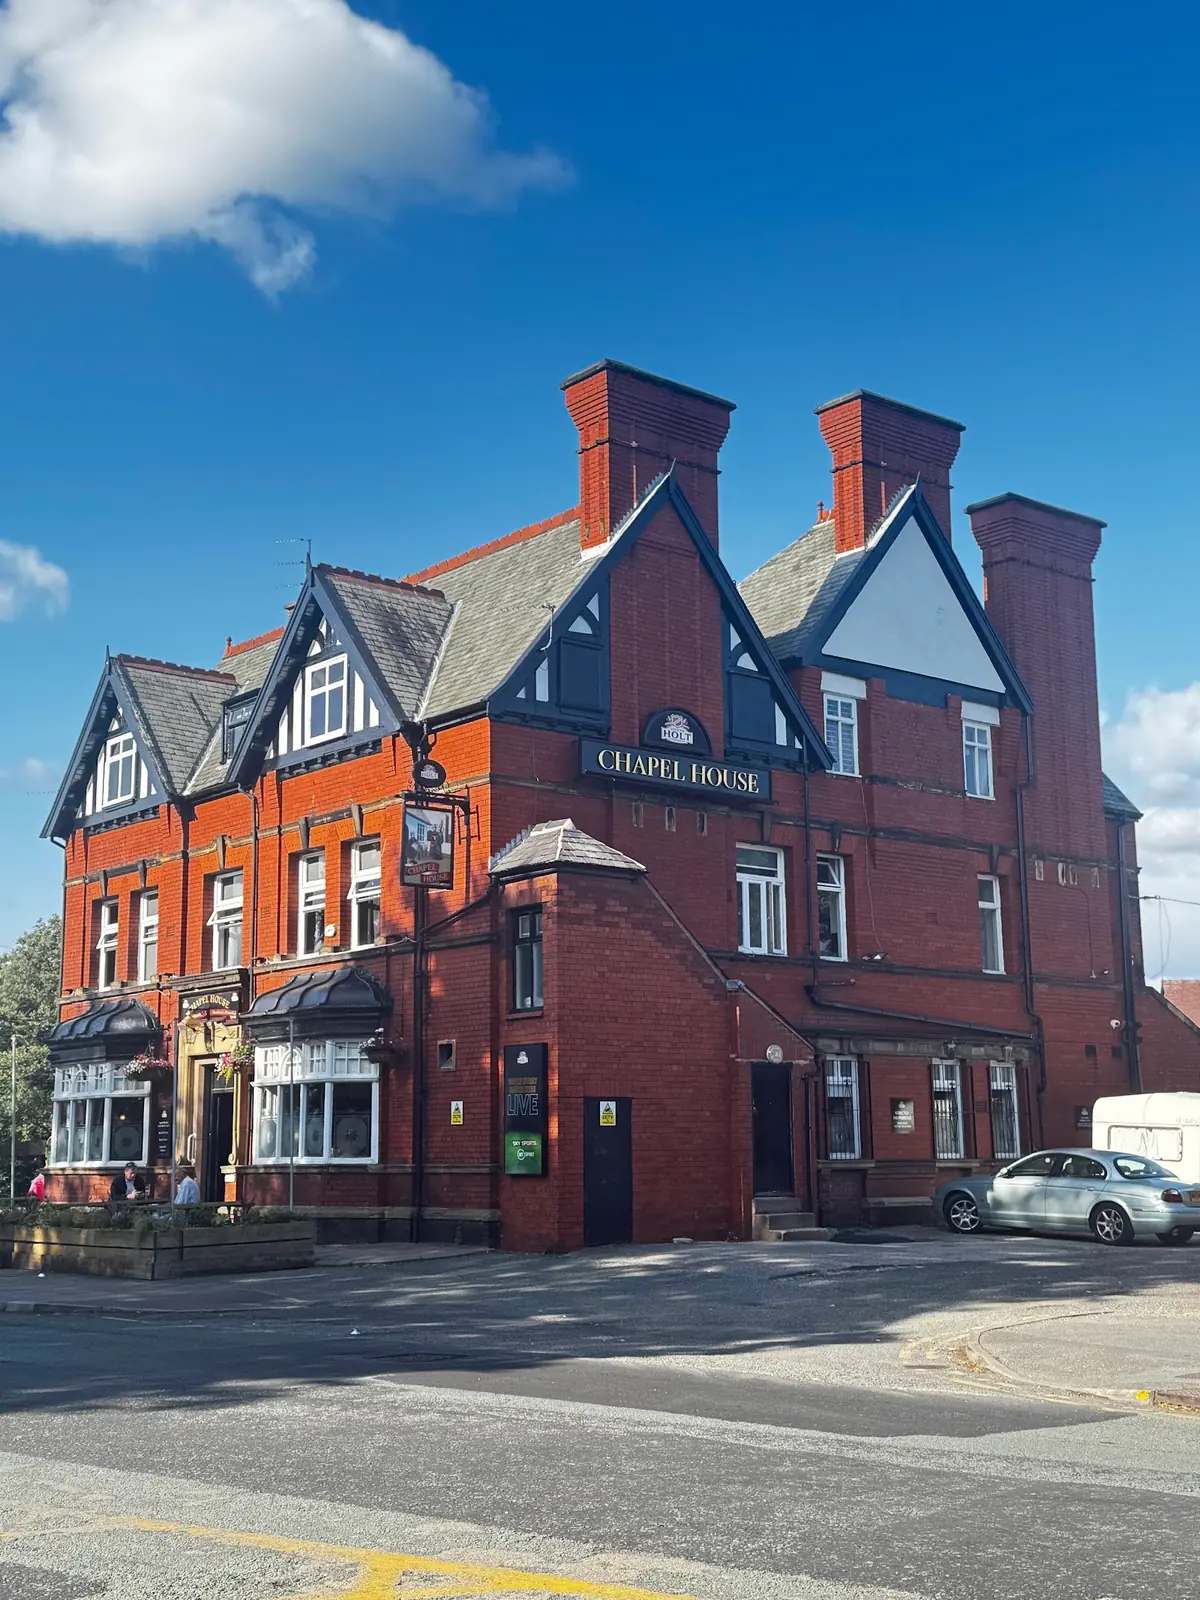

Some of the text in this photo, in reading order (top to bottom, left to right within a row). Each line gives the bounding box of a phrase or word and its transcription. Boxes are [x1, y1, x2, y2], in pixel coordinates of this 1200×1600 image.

[663, 729, 692, 741] HOLT
[598, 749, 759, 793] CHAPEL HOUSE
[408, 863, 437, 875] CHAPEL
[423, 873, 449, 882] HOUSE
[210, 994, 230, 1009] HOUSE
[507, 1093, 539, 1116] LIVE
